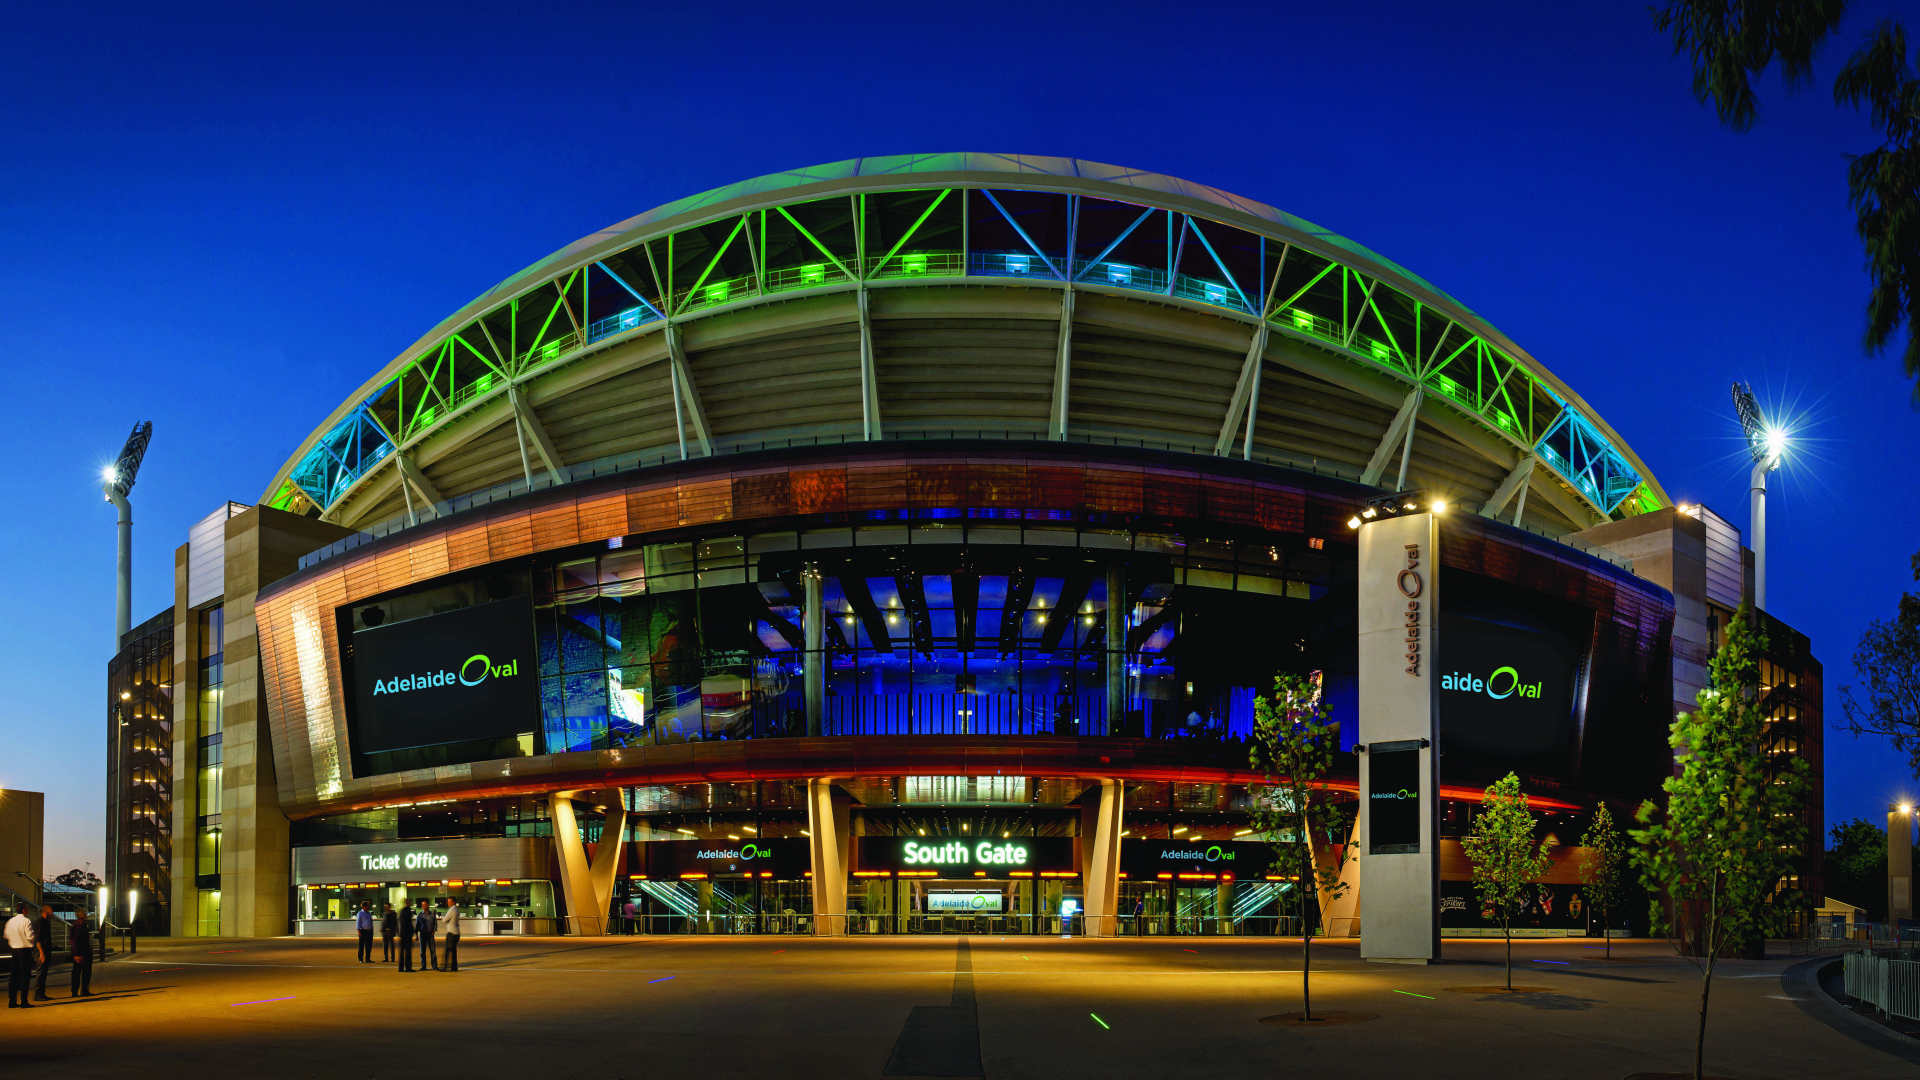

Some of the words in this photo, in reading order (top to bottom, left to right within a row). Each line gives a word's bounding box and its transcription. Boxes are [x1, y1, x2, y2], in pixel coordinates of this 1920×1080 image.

[1397, 543, 1421, 599] Oval
[1404, 600, 1419, 677] Adelaide
[373, 669, 456, 696] Adelaide
[459, 654, 518, 687] Oval
[1441, 671, 1484, 693] aide
[1486, 666, 1542, 700] Oval
[1396, 788, 1418, 800] Oval
[360, 854, 401, 871] Ticket
[405, 852, 449, 870] Office
[696, 849, 739, 860] Adelaide
[739, 843, 771, 861] Oval
[903, 841, 969, 865] South
[976, 842, 1028, 865] Gate
[1160, 849, 1204, 860] Adelaide
[1205, 845, 1236, 862] Oval
[932, 899, 970, 908] Adelaide
[971, 895, 998, 909] Oval
